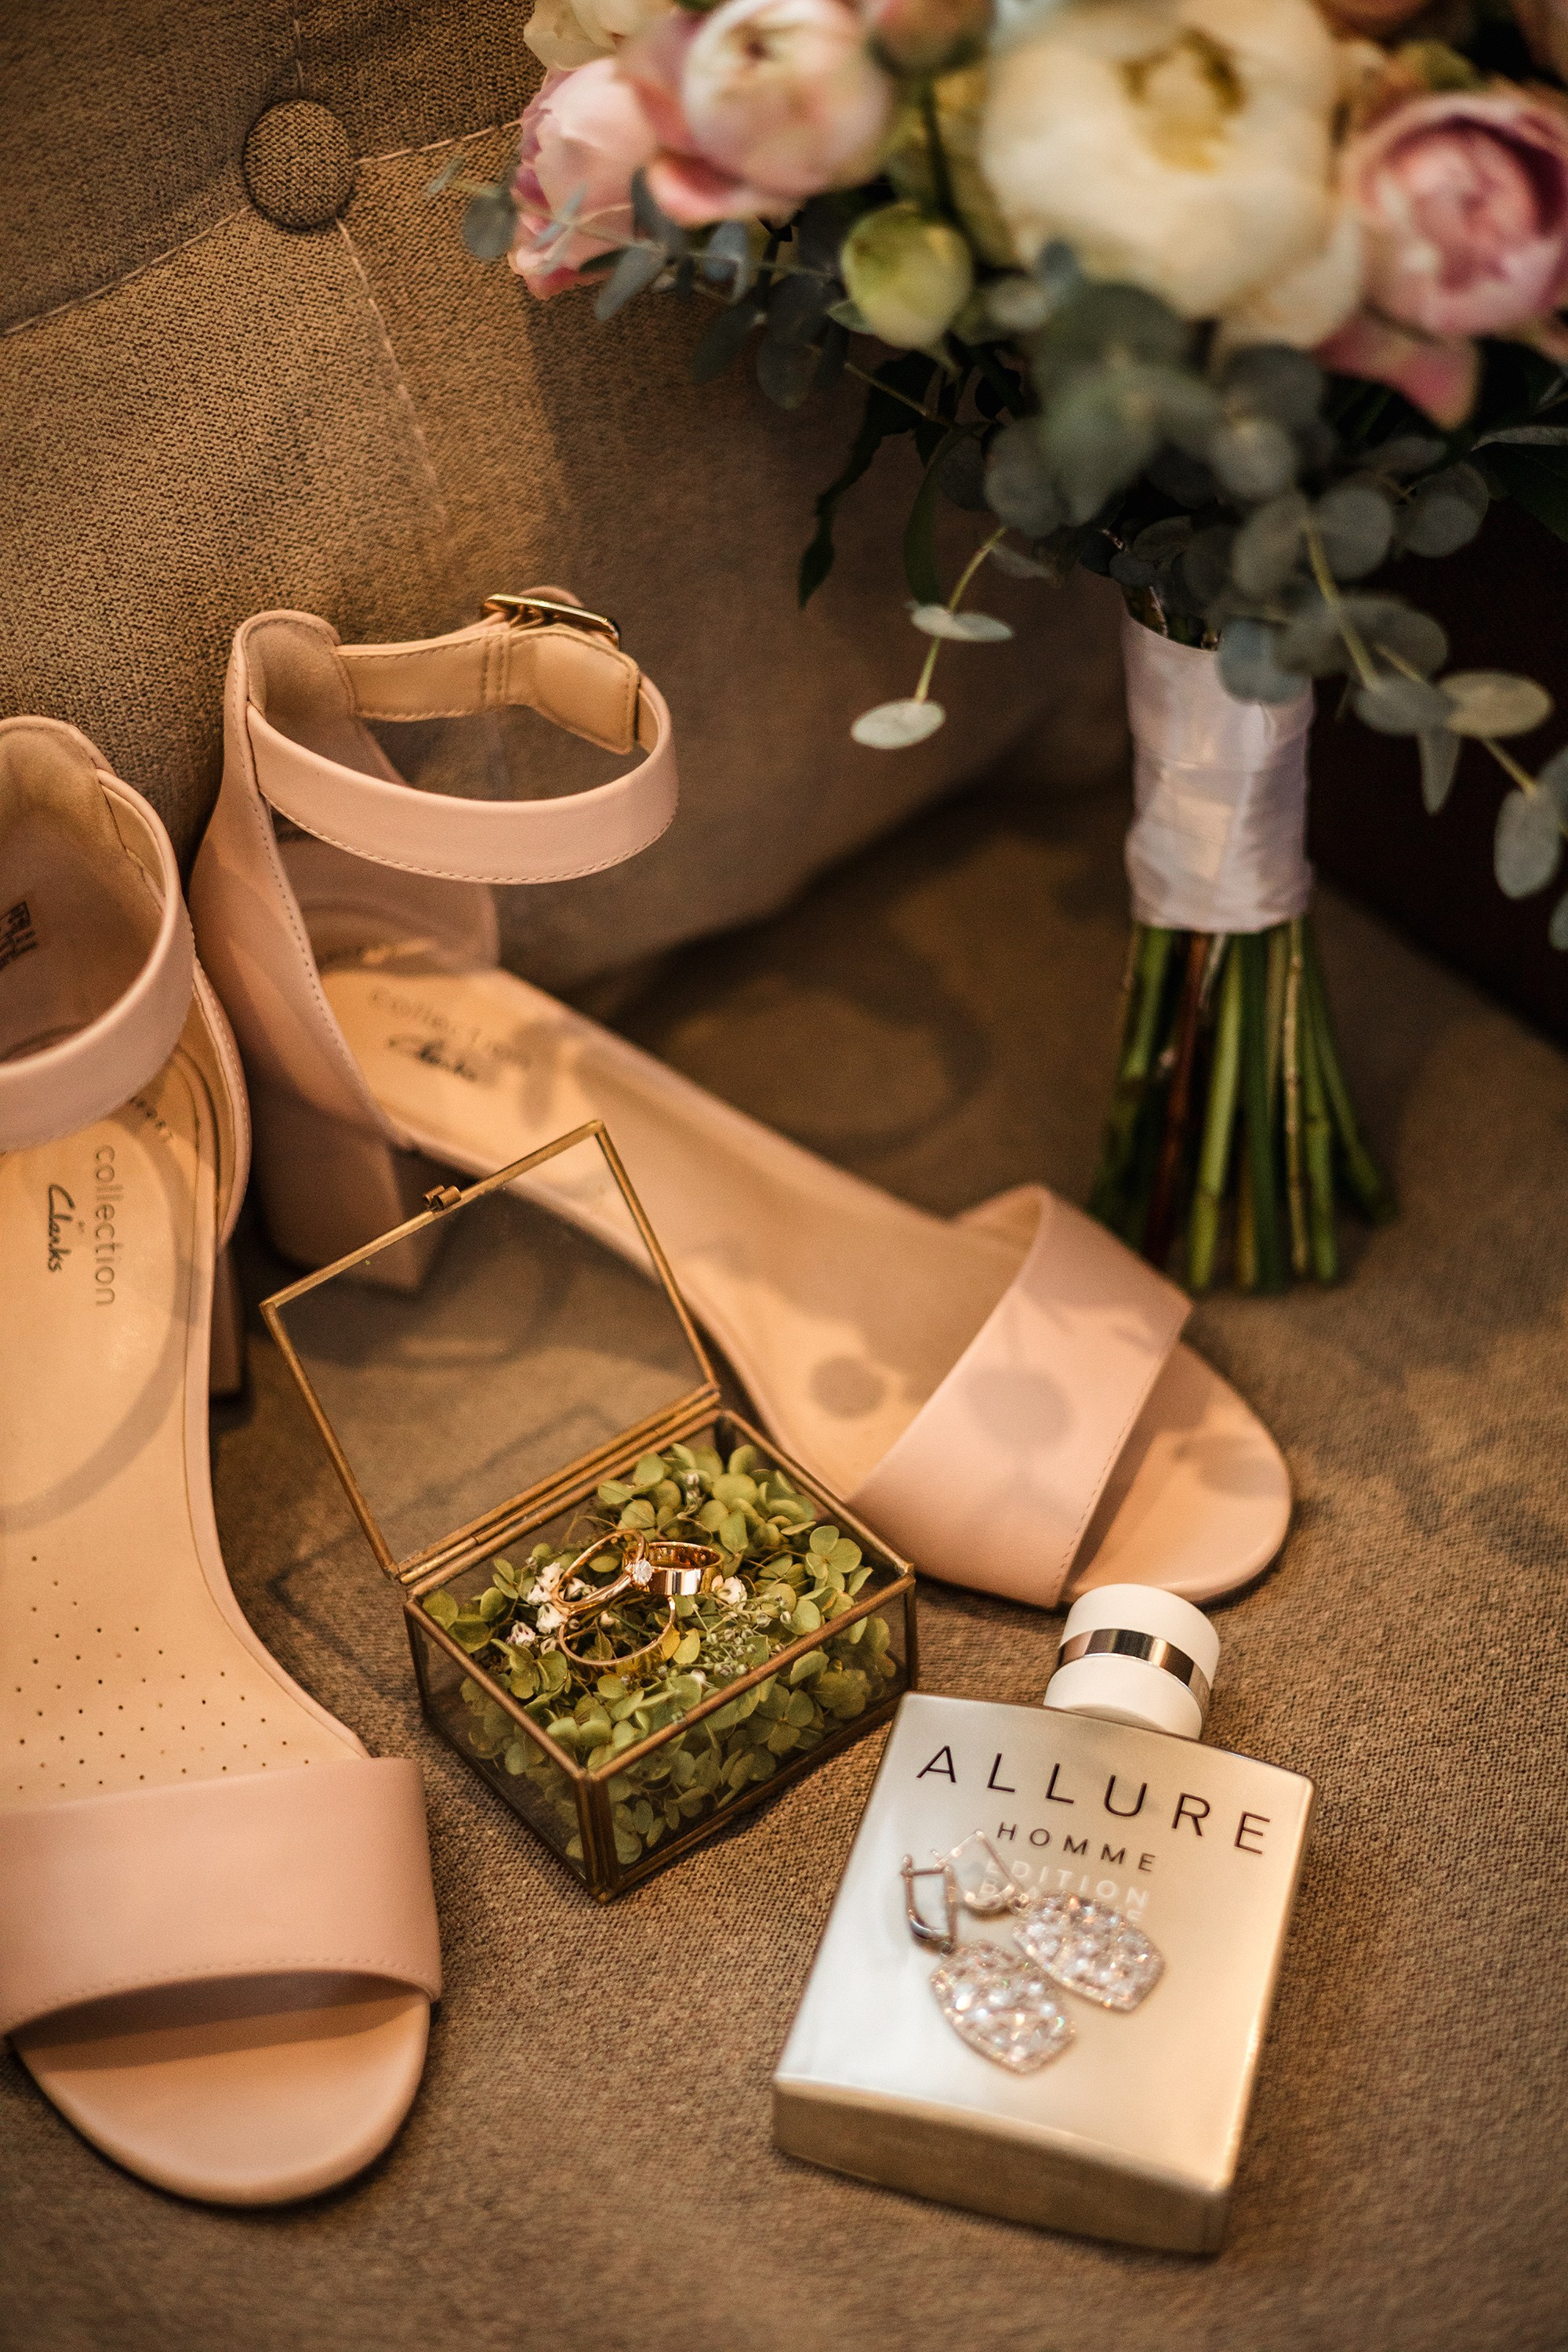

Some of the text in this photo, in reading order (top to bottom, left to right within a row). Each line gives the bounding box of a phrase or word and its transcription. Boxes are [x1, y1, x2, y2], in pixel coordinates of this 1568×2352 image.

[47, 1183, 76, 1272] Clarks
[94, 1145, 124, 1307] collection
[916, 1744, 1271, 1855] ALLURE
[996, 1820, 1157, 1873] HOMME
